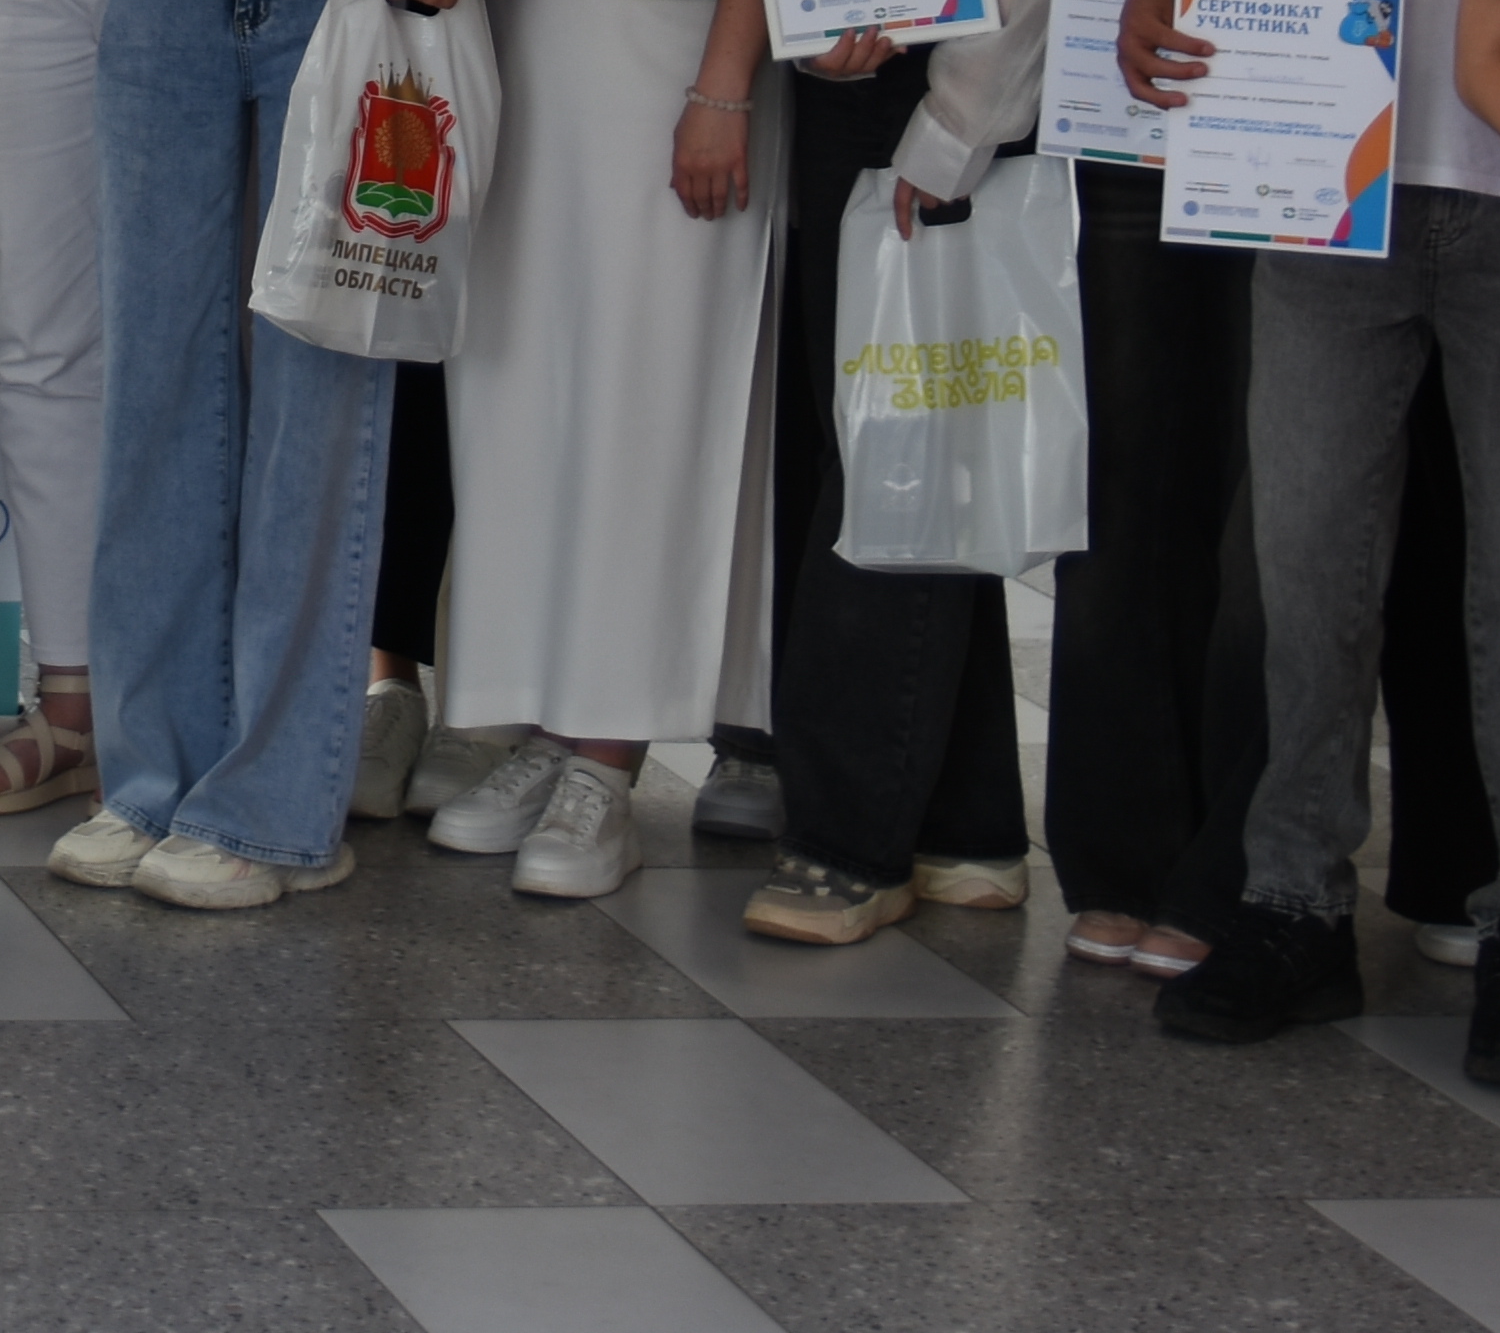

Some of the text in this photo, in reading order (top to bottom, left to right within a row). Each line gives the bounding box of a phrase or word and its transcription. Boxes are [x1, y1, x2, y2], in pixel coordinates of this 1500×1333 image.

[1195, 14, 1310, 36] УЧАСТНИКА
[331, 239, 438, 274] ЛИПЕЦКАЯ
[334, 268, 424, 300] ОБЛАСТЬ
